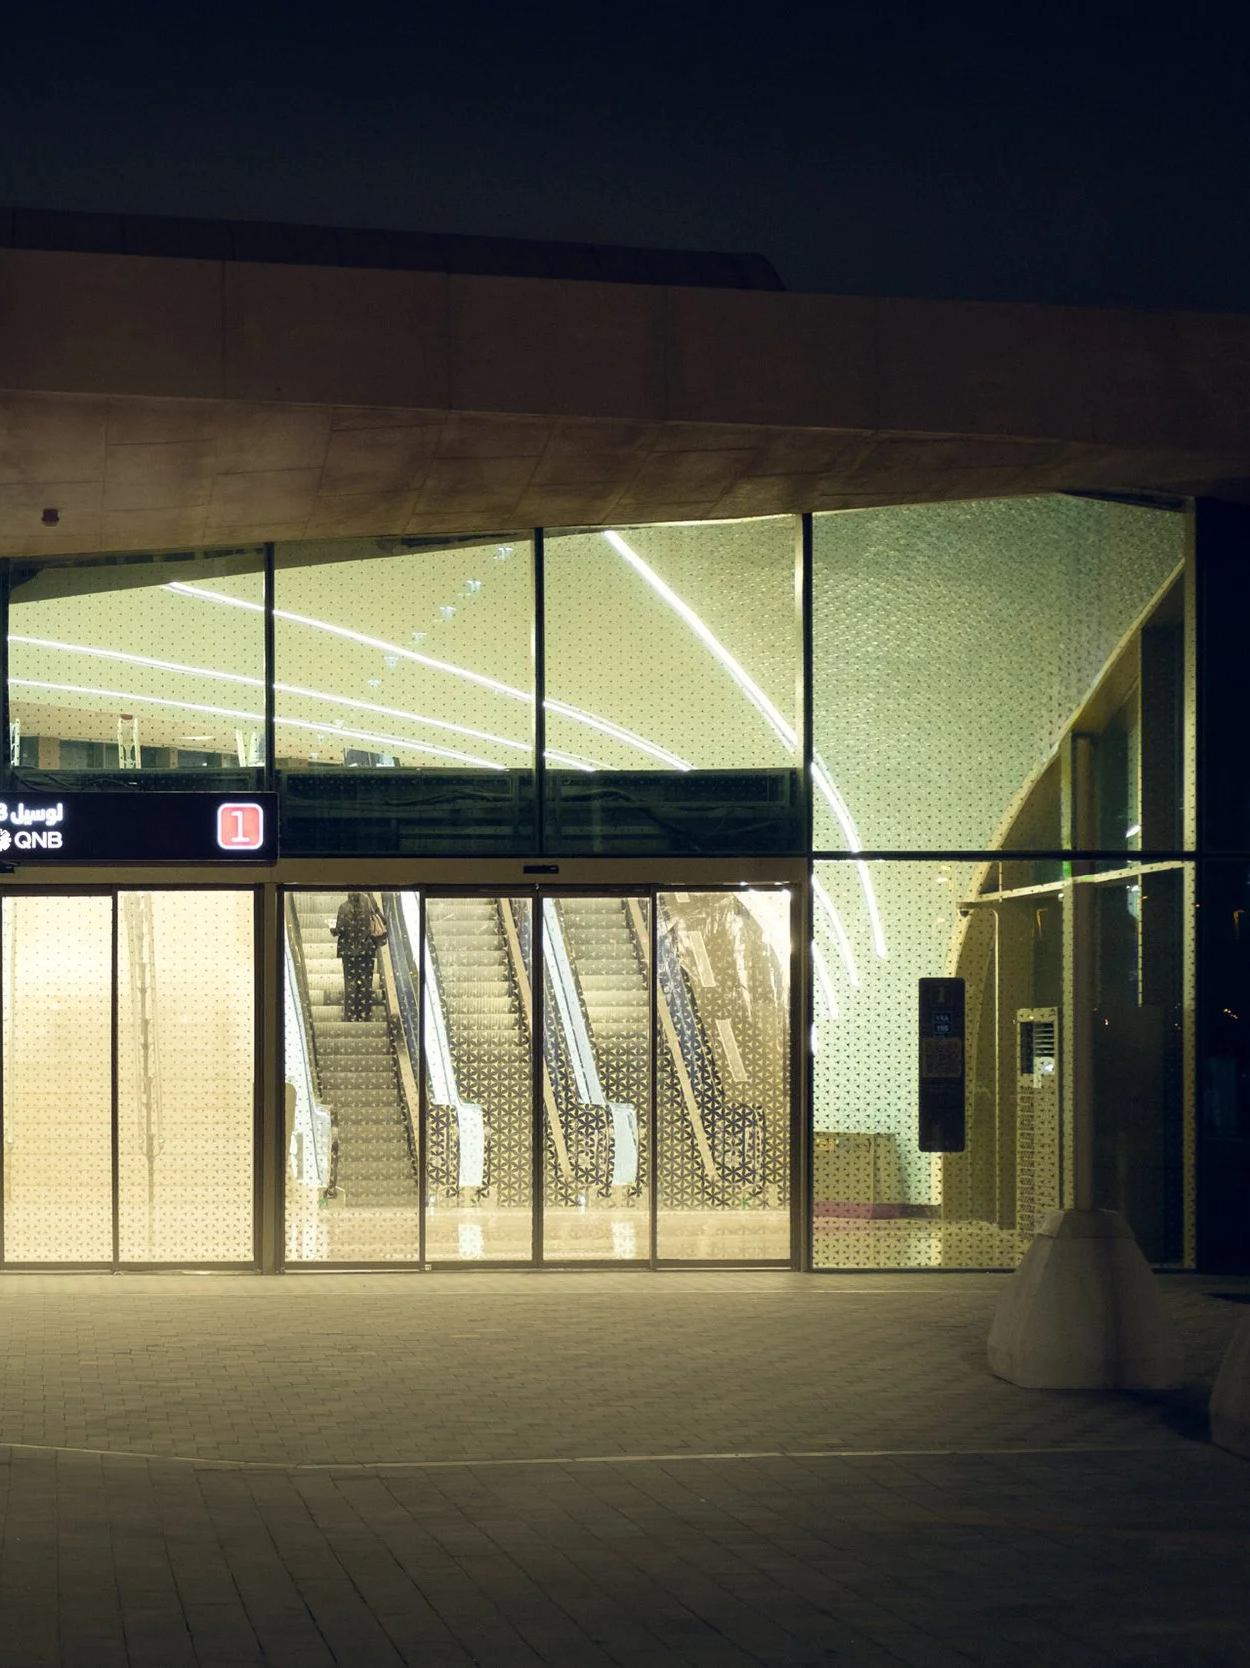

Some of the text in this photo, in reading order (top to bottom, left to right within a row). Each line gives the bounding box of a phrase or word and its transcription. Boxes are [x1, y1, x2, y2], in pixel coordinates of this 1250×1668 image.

[10, 802, 64, 826] لوسيل
[230, 810, 251, 843] 1
[13, 831, 63, 849] QNB
